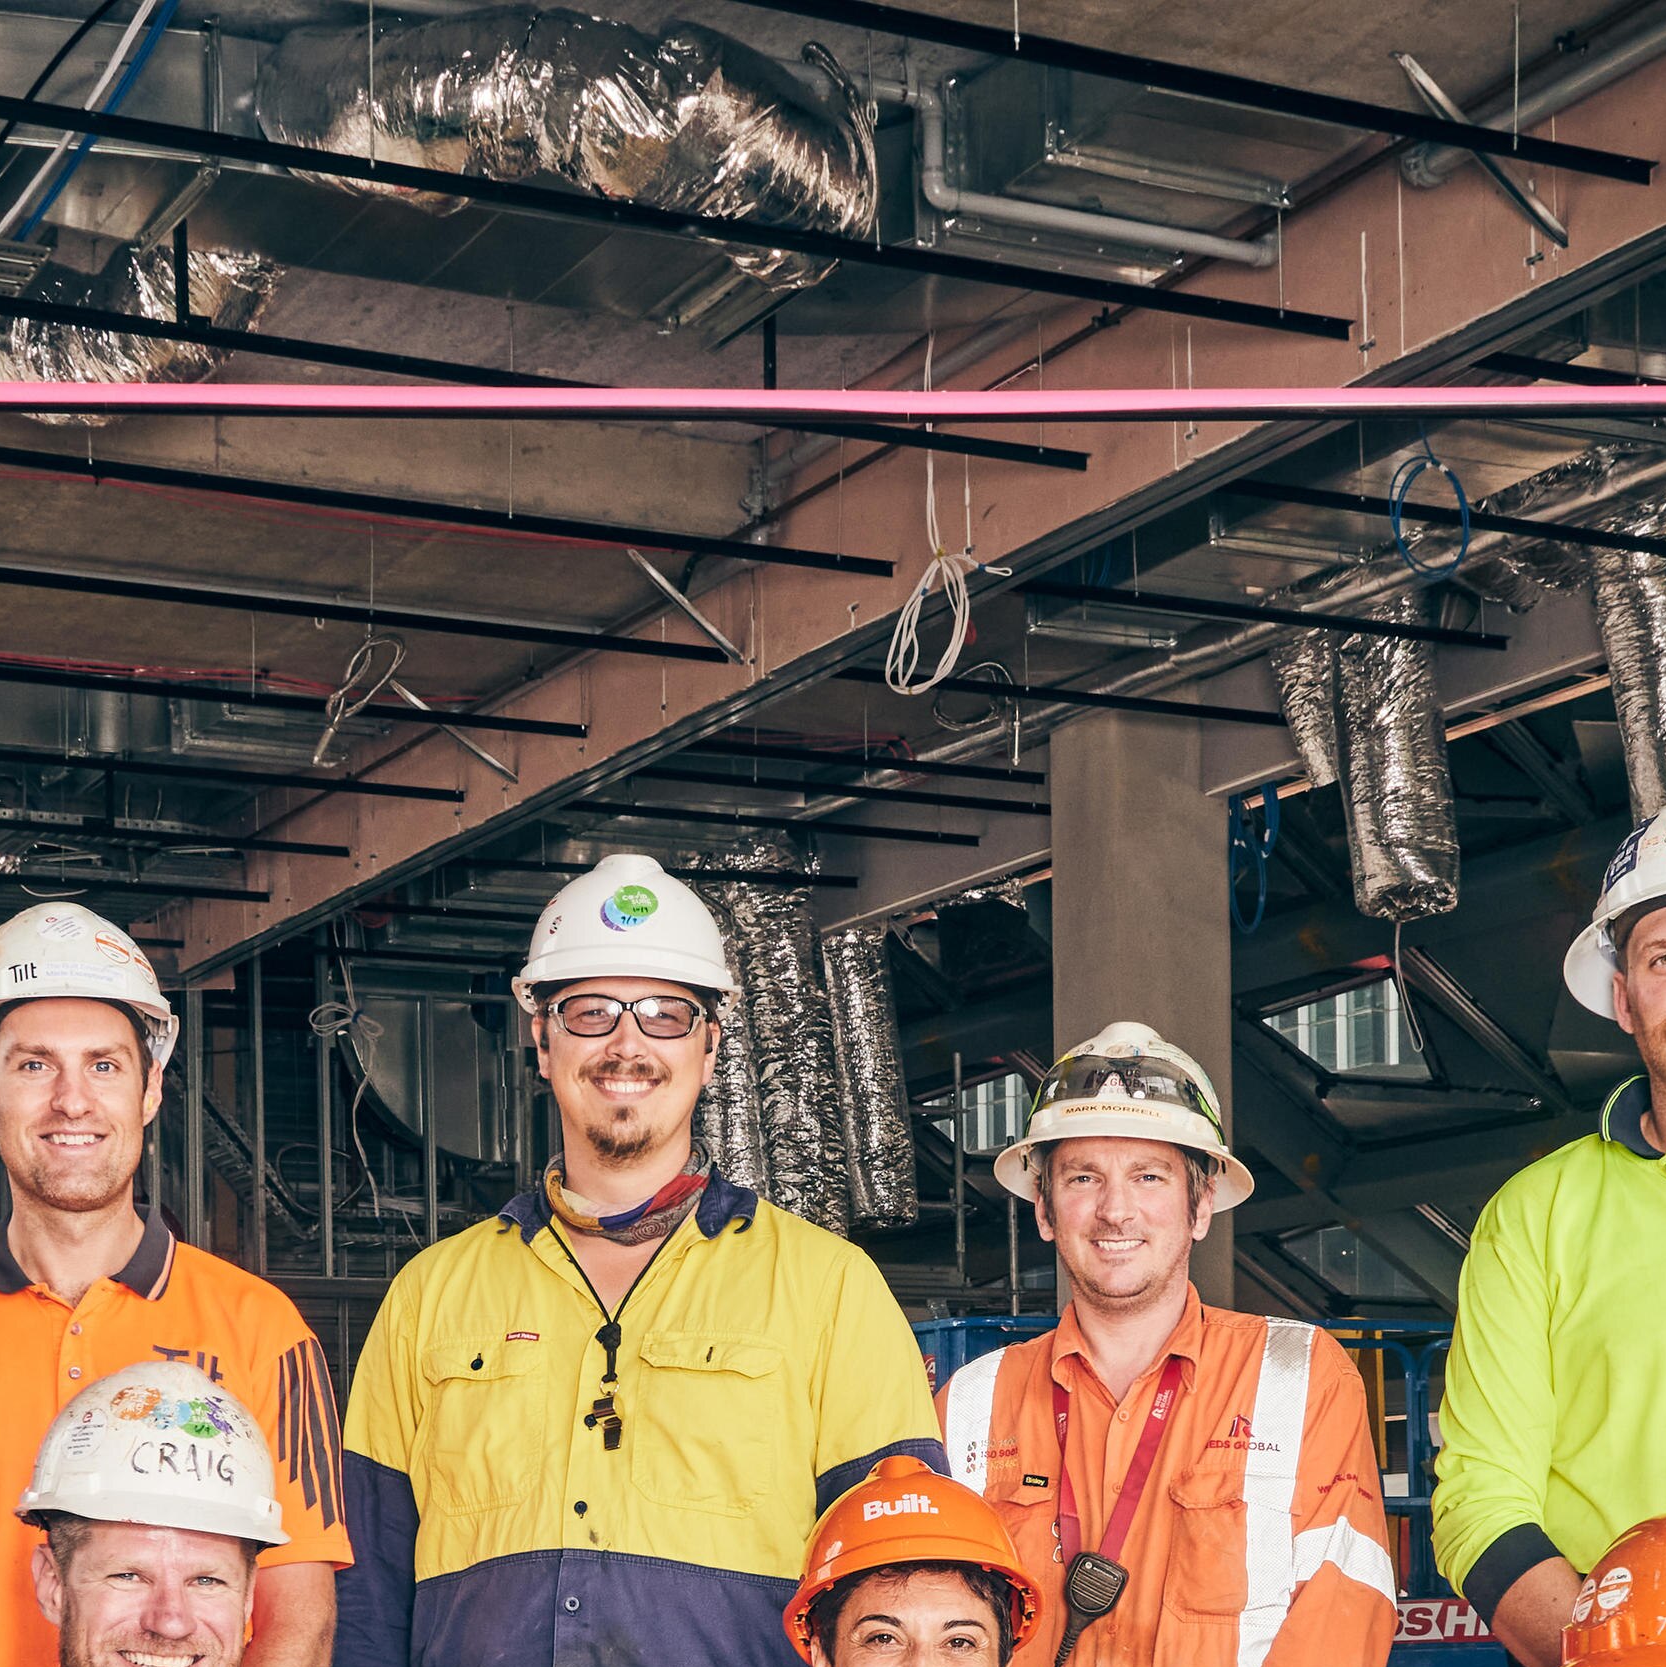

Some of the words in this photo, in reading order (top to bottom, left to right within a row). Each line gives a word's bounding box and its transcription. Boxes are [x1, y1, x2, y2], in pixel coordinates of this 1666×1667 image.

[8, 962, 37, 983] Tilt
[1066, 1105, 1097, 1114] MARK
[1102, 1104, 1162, 1118] MORRELL
[1233, 1441, 1281, 1452] GLOBAL
[132, 1441, 234, 1487] CRAIG
[863, 1494, 939, 1521] Built.
